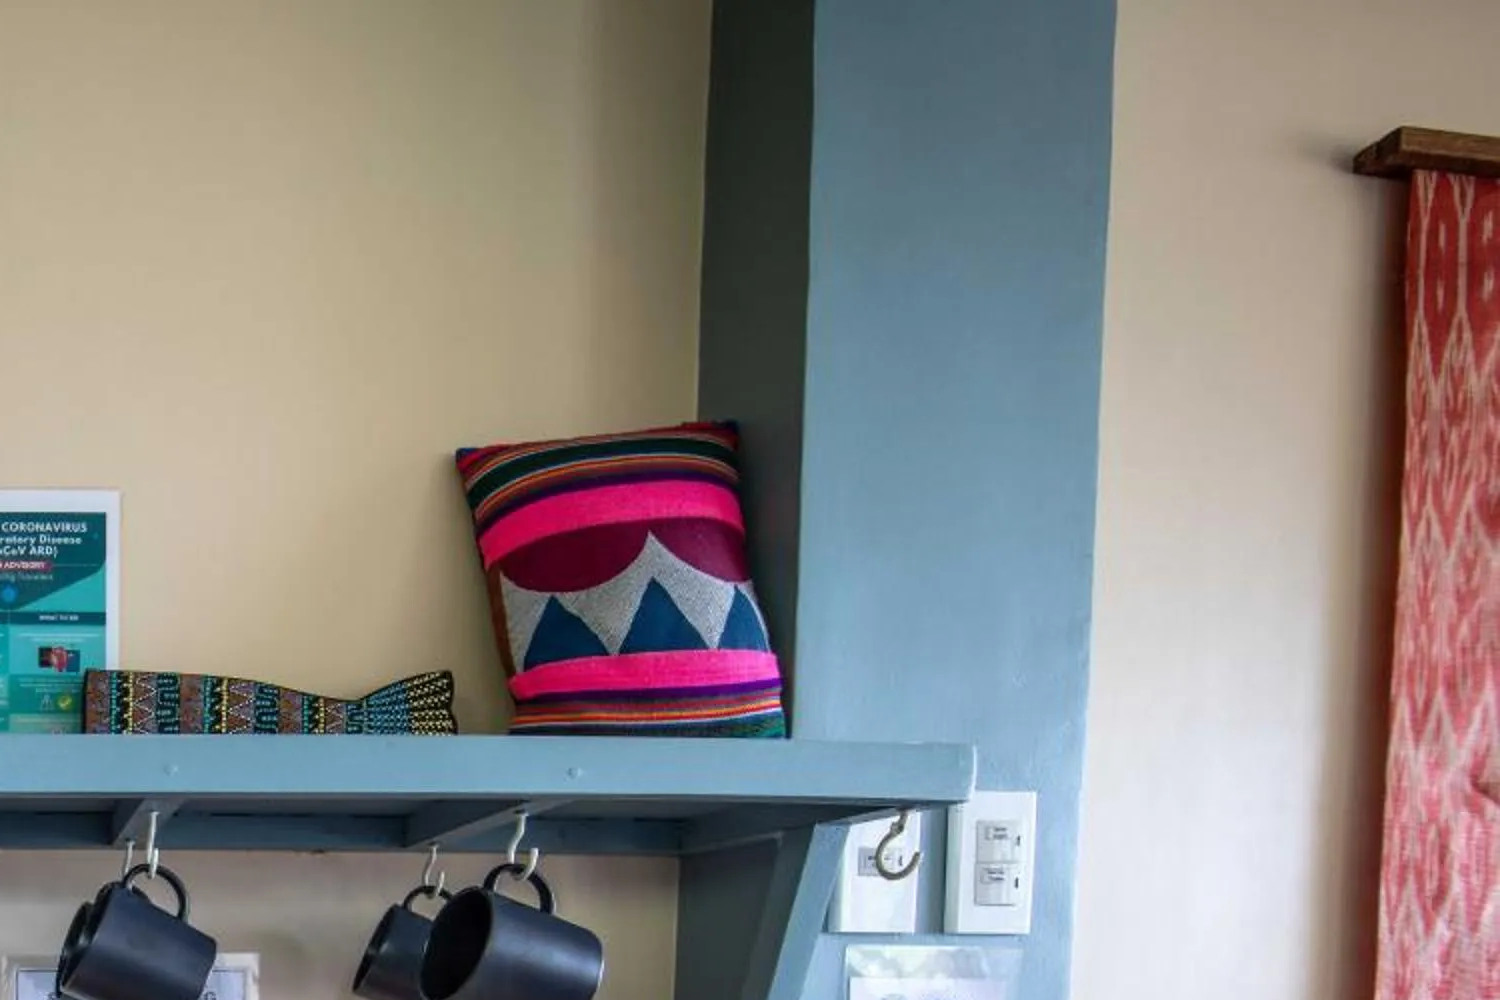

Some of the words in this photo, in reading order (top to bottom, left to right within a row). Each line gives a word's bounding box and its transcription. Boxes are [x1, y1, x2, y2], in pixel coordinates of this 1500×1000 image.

[1, 521, 88, 533] CORONAVIRUS
[39, 535, 82, 545] Disease
[29, 545, 58, 558] ARD)
[4, 561, 46, 569] ADVISORY
